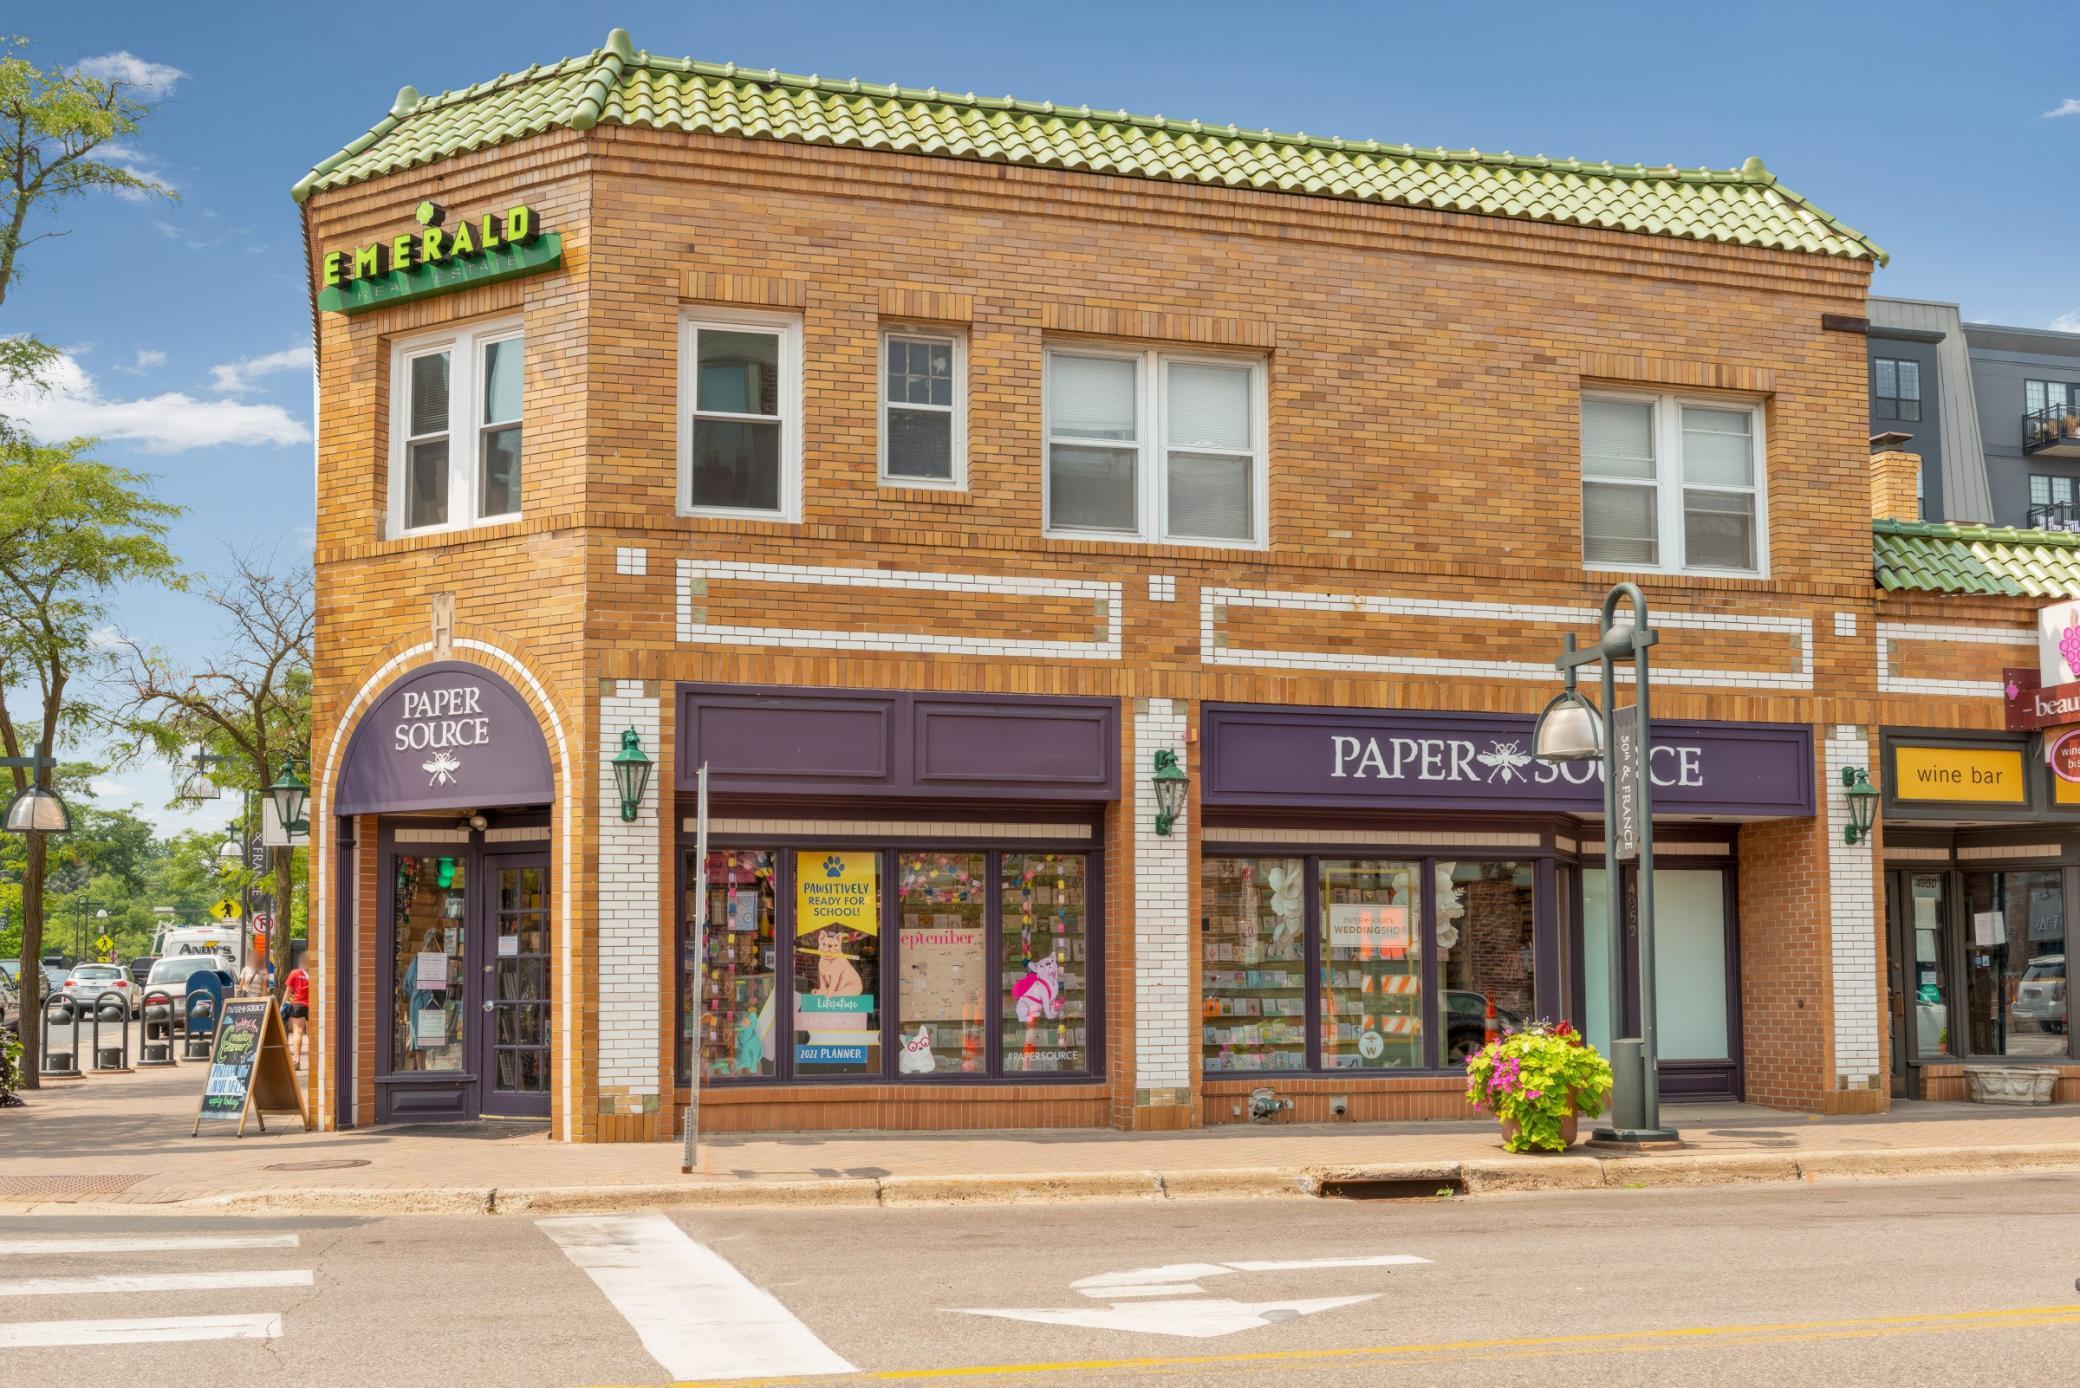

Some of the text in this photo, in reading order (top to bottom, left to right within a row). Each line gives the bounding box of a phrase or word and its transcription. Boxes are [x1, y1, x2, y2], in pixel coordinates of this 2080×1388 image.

[323, 204, 532, 286] EMERALD
[434, 255, 516, 283] ESTATE
[402, 687, 482, 719] PAPER
[2034, 694, 2080, 717] beau
[395, 718, 489, 750] SOURCE
[1330, 736, 1704, 786] PAPER SOCE
[1917, 765, 2003, 784] wine bar
[1621, 735, 1633, 850] 50th & FRANCE
[804, 882, 869, 894] PAWSITIVELY
[808, 896, 865, 905] READY FOR
[814, 907, 861, 917] SCHOOL!
[817, 997, 858, 1010] Literature
[800, 1047, 862, 1059] 2022 PLANNER
[1007, 1050, 1079, 1061] #PAPERSOURCE
